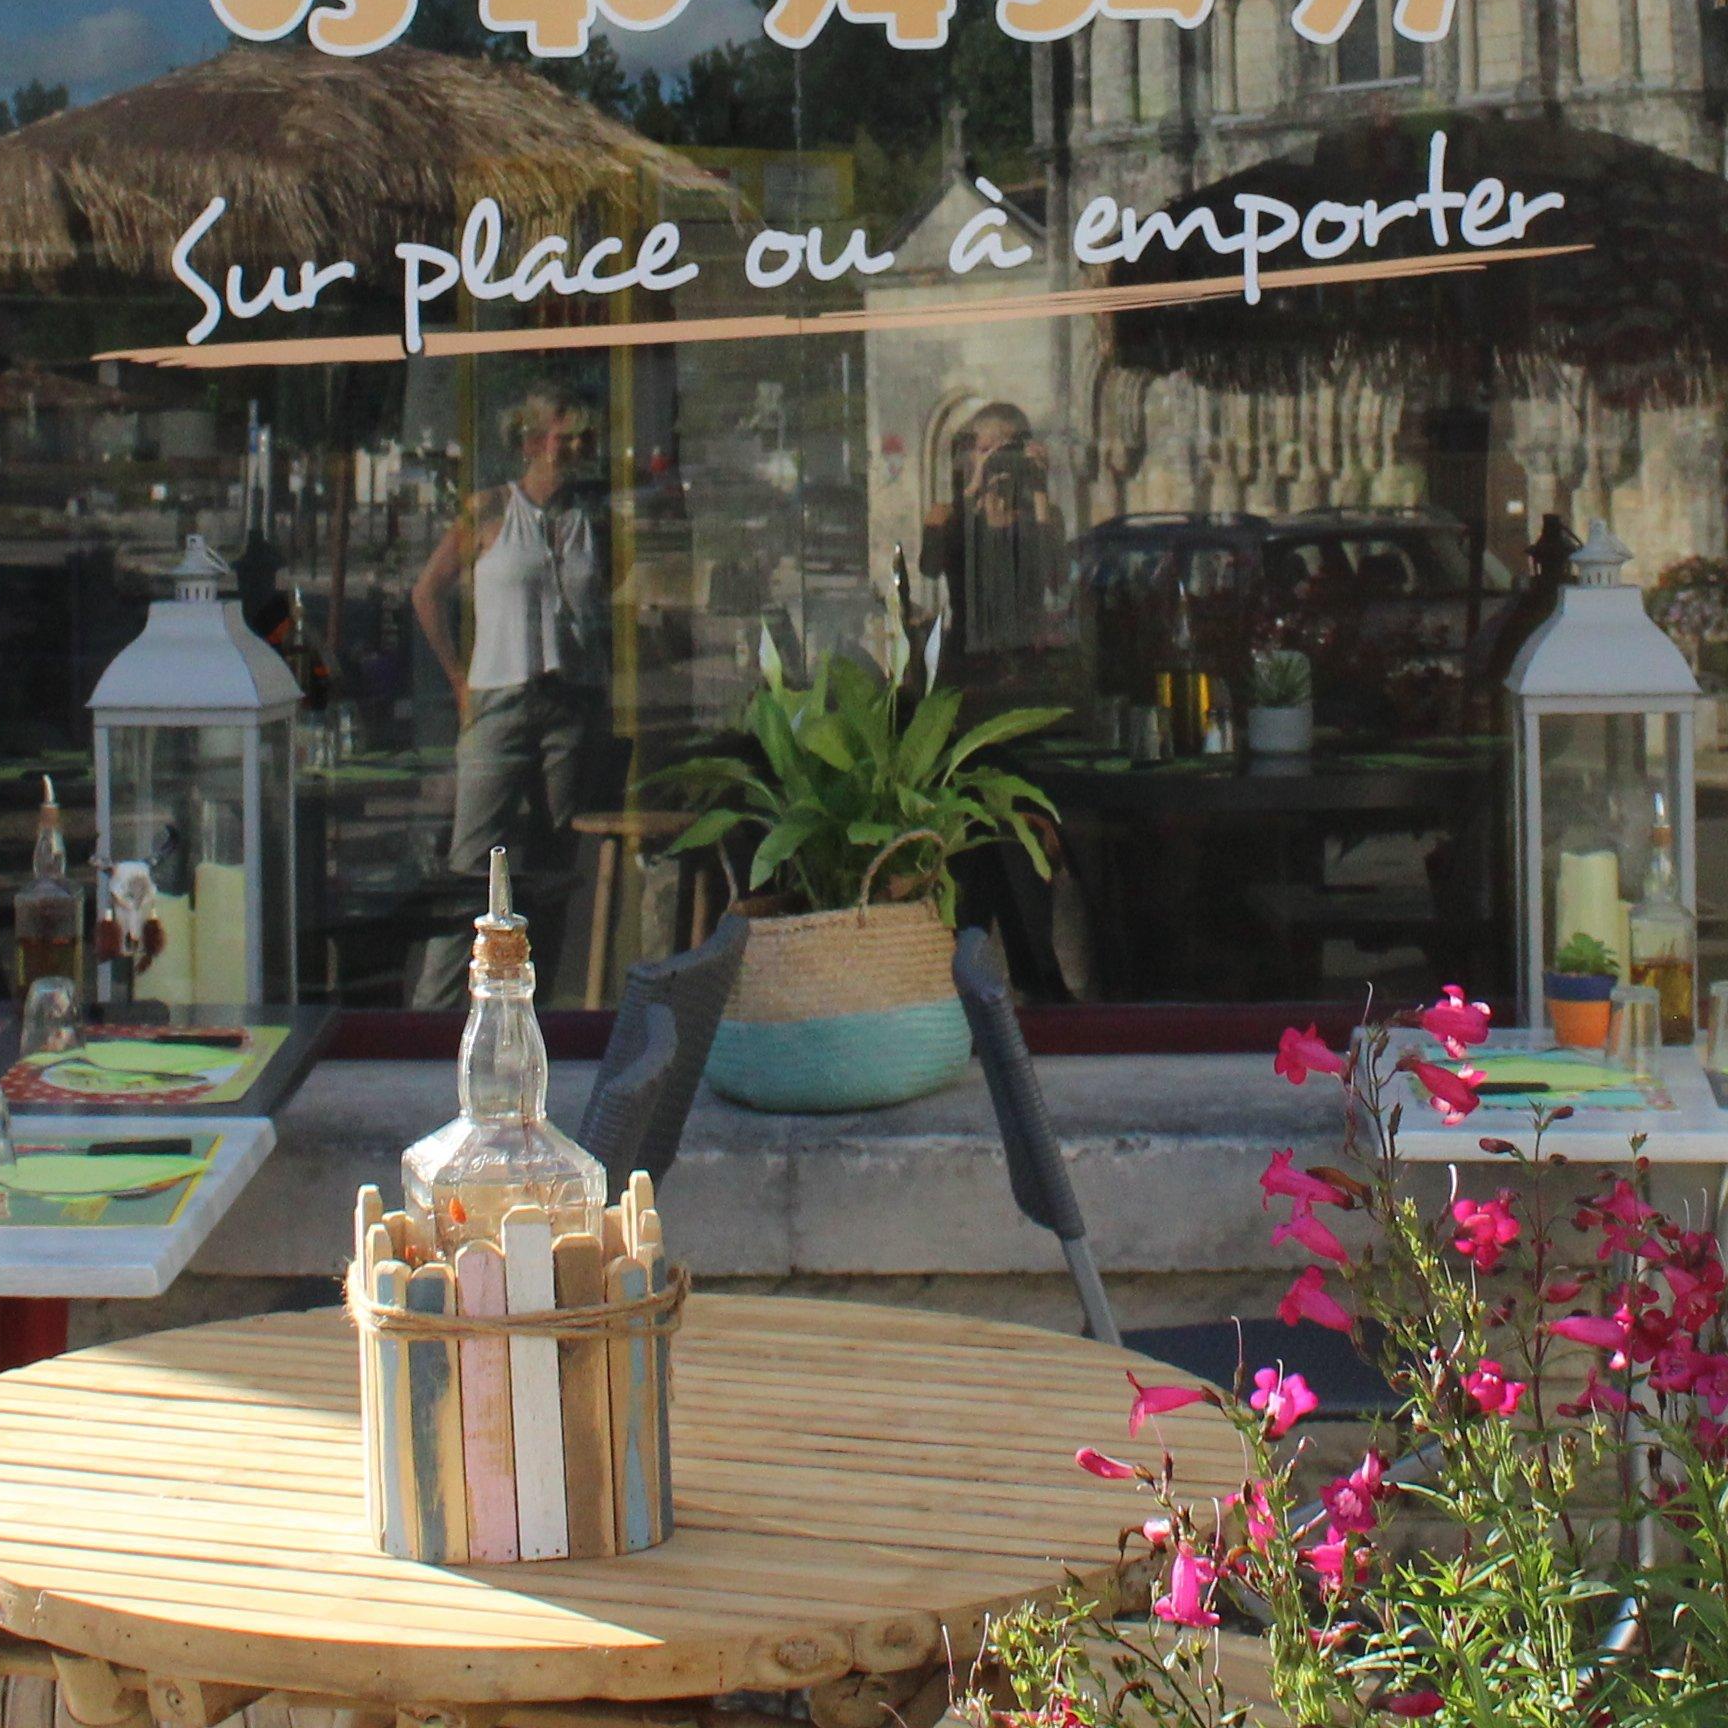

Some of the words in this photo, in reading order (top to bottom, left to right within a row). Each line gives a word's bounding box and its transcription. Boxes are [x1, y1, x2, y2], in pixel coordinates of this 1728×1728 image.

[171, 196, 355, 345] Sur
[394, 197, 699, 354] place
[745, 225, 896, 289] ou
[948, 176, 1033, 274] à
[1073, 130, 1565, 305] emporter
